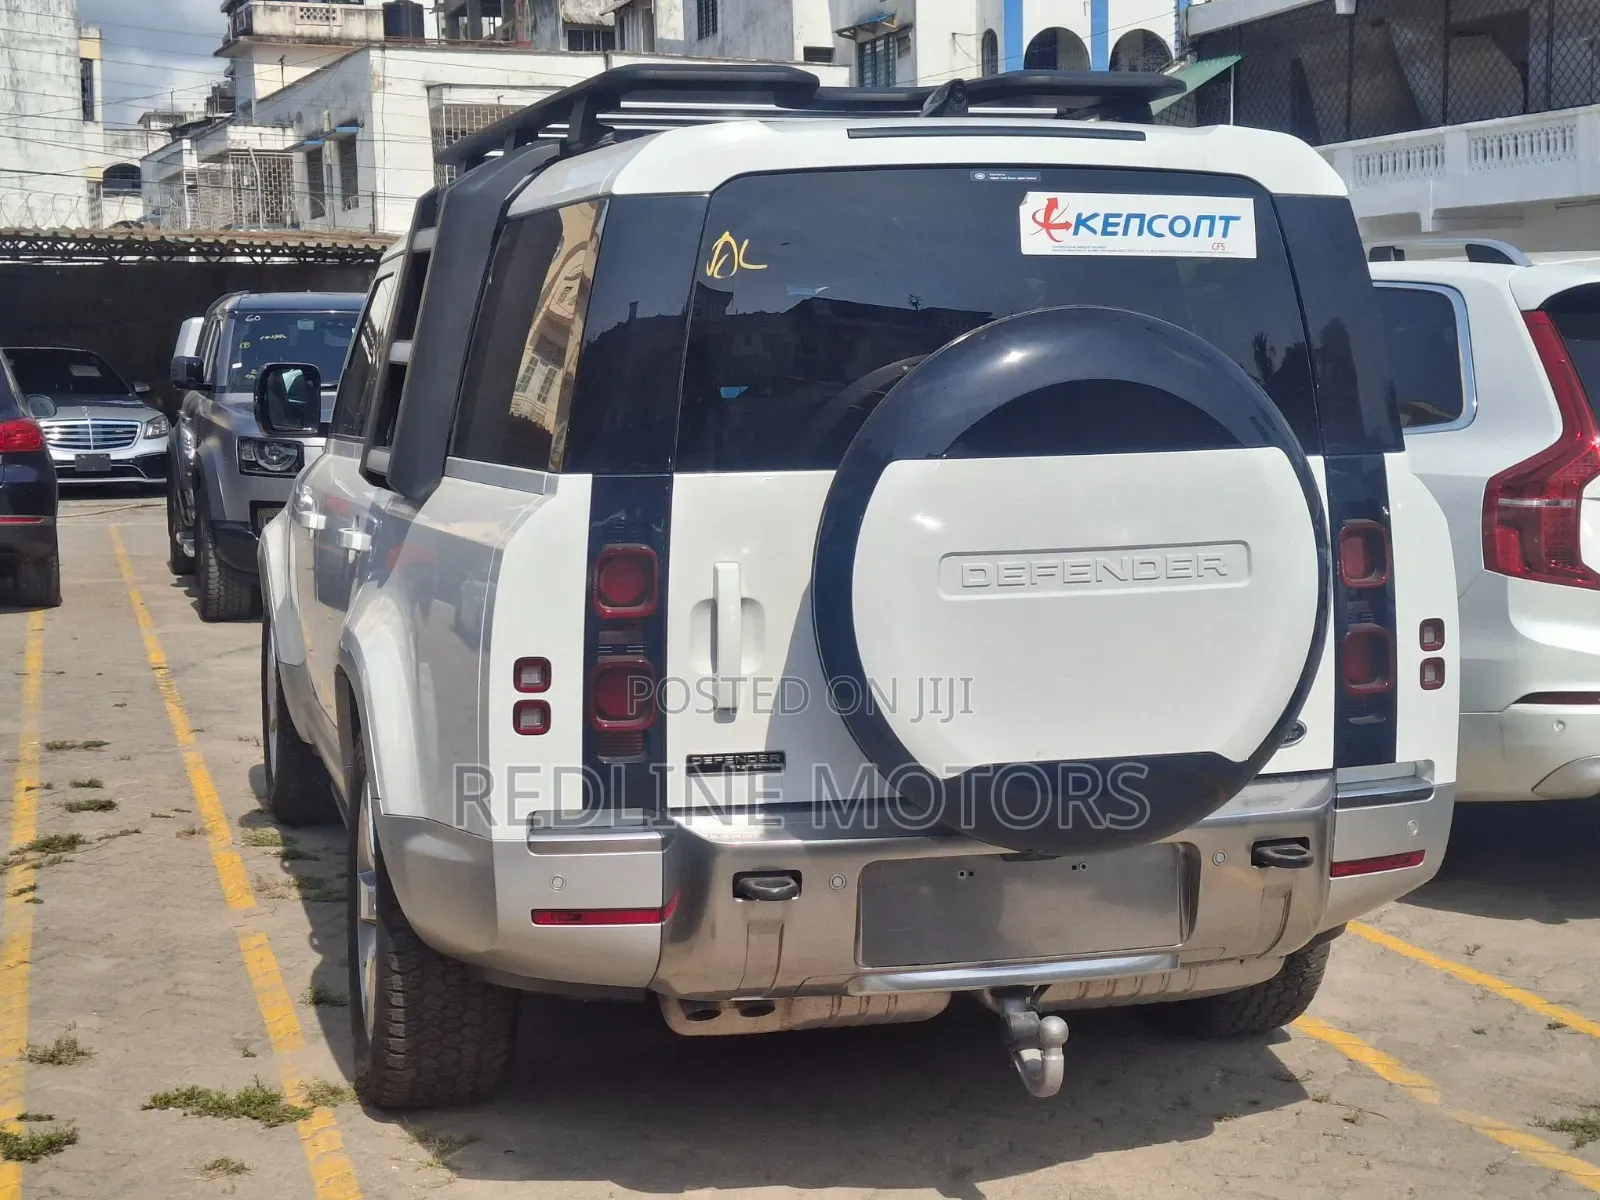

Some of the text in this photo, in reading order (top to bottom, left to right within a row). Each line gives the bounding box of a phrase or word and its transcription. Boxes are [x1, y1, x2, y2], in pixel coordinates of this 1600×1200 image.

[1211, 242, 1226, 251] CFS
[962, 553, 1228, 588] DEFENDER
[691, 754, 781, 765] DEFENDER
